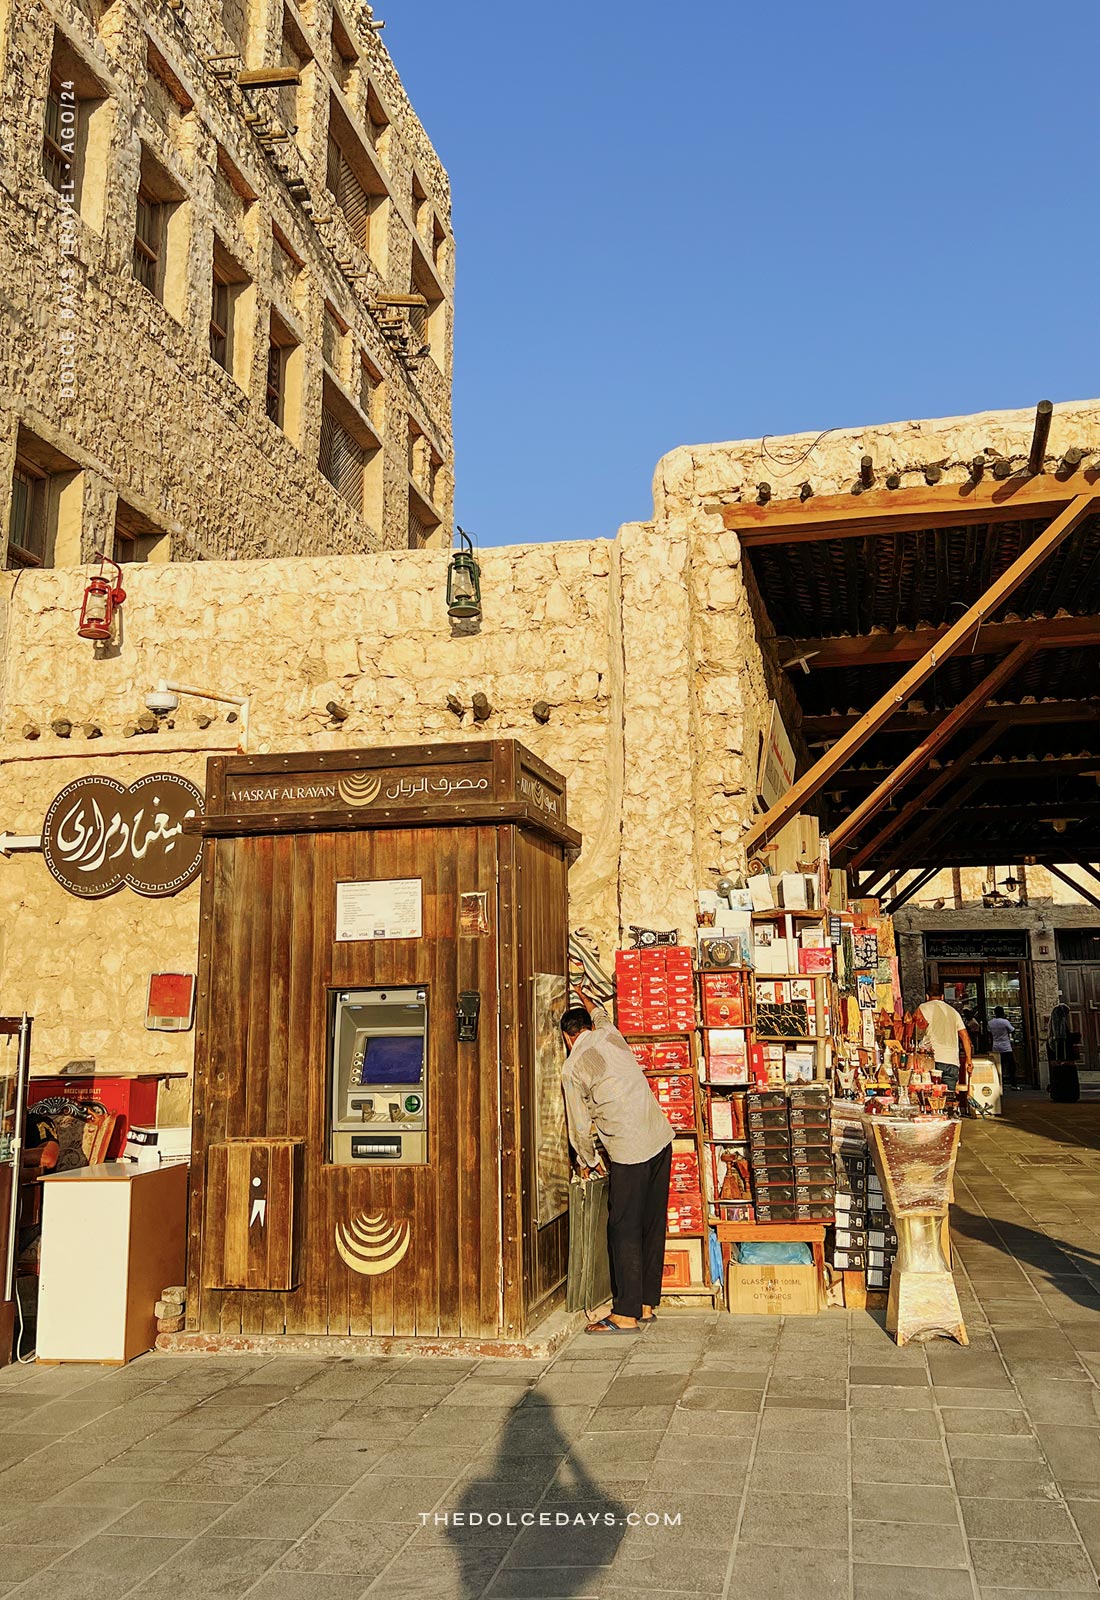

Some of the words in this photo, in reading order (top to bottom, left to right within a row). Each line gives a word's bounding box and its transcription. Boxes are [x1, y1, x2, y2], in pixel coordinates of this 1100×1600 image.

[386, 777, 430, 799] الريان
[430, 776, 488, 797] مصرف
[231, 789, 280, 802] MASRAF
[929, 945, 975, 953] Al-Shahab
[980, 944, 1023, 953] Jewellery
